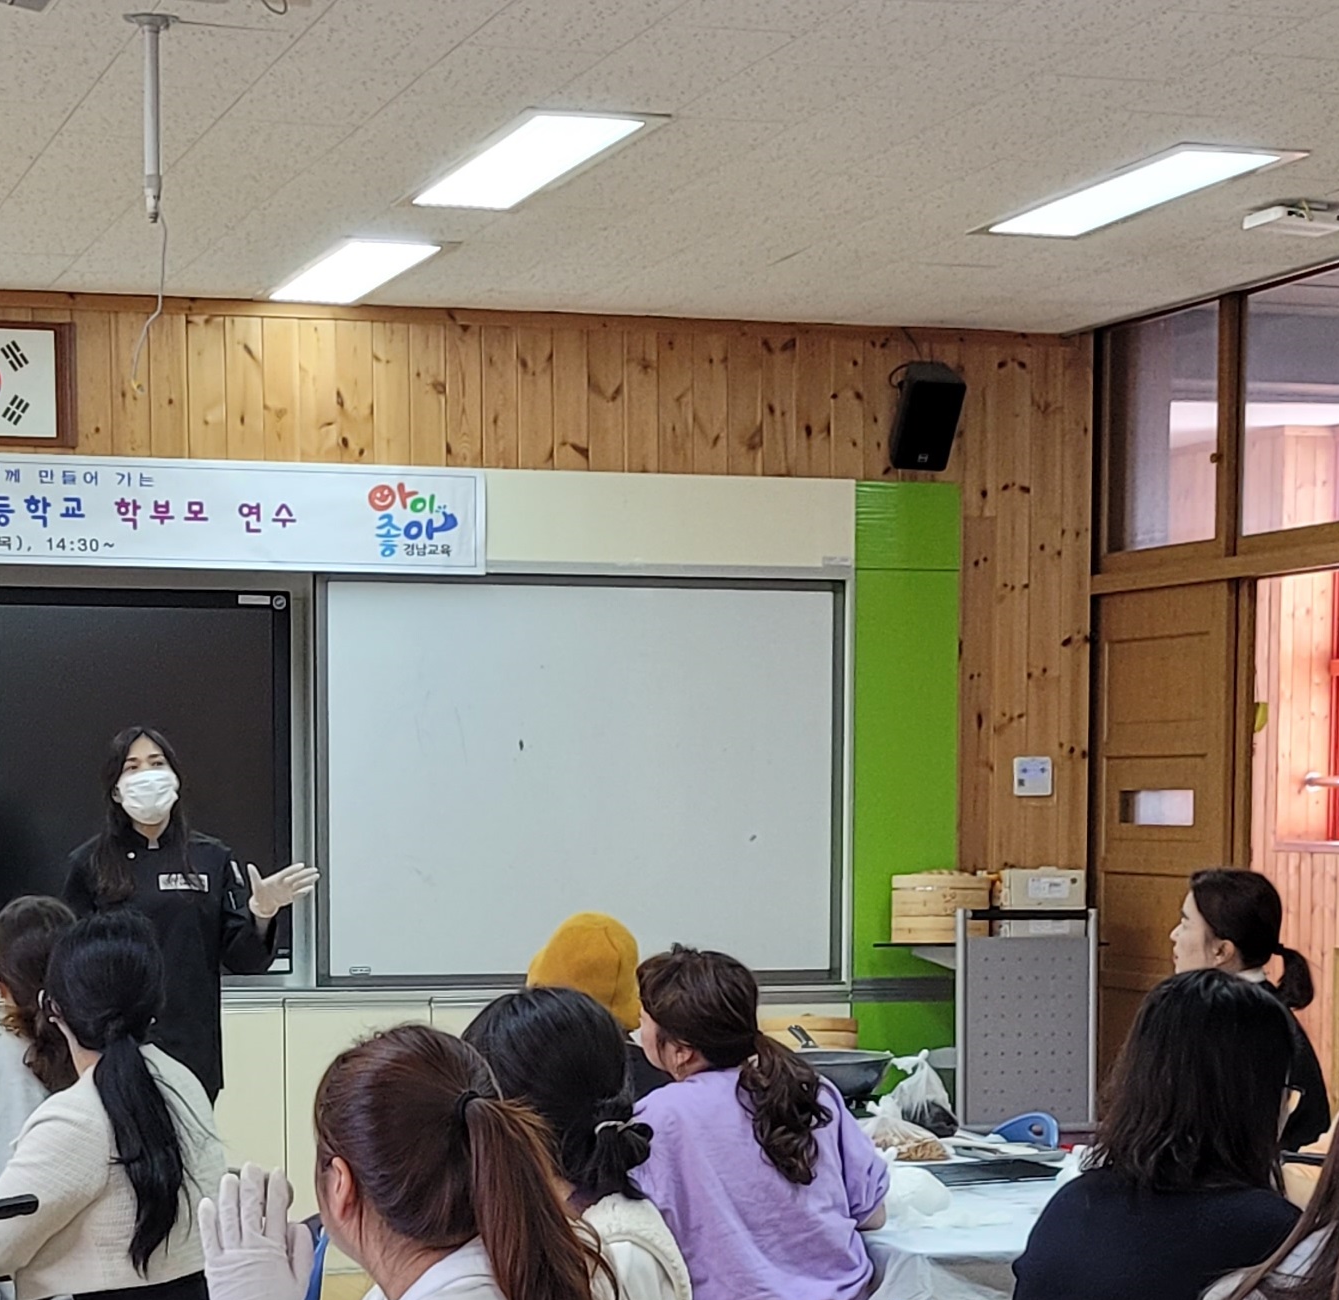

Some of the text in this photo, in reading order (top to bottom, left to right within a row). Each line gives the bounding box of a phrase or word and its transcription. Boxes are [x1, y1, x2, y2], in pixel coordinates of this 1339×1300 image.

[38, 468, 99, 486] 만들어
[116, 472, 155, 488] 가는
[114, 497, 210, 531] 학부모
[238, 501, 297, 534] 연수
[46, 538, 115, 553] 14:30~
[403, 543, 451, 557] 경남교육
